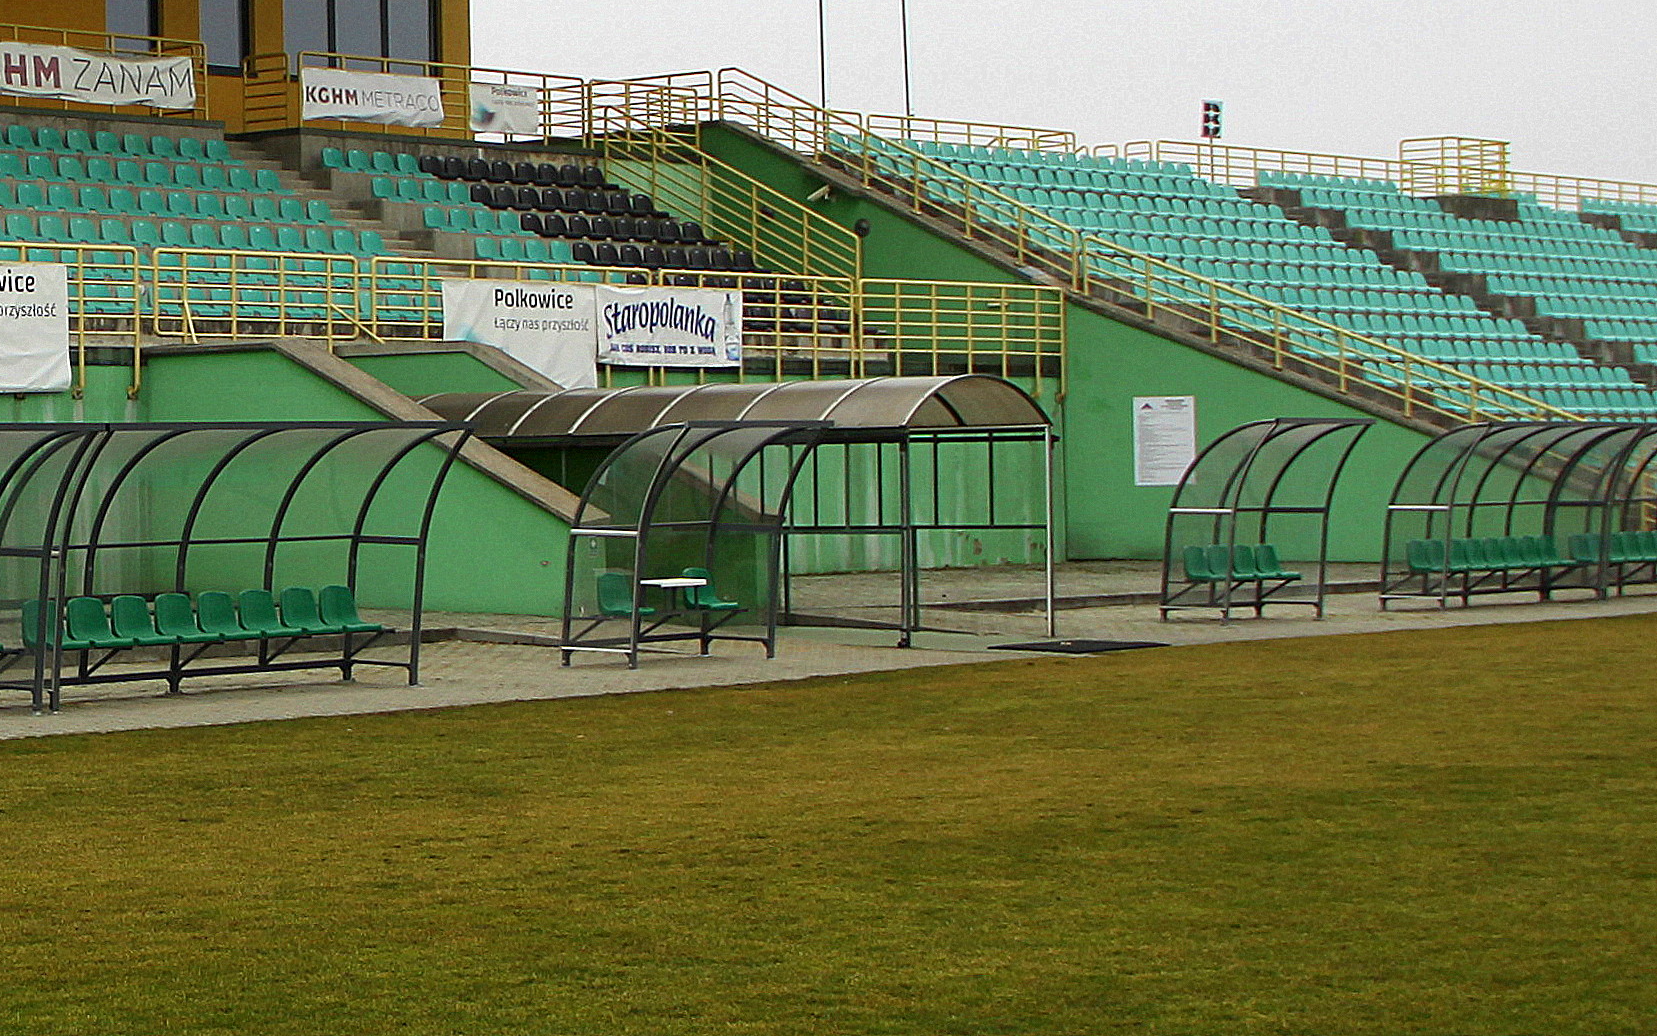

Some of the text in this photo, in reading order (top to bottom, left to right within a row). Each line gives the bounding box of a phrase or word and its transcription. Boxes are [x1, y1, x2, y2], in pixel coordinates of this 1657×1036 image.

[73, 58, 193, 98] ZANAM
[306, 86, 439, 112] KGHM METRACO
[494, 288, 573, 309] Polkowice
[523, 319, 539, 329] nas
[604, 297, 716, 342] Staropolanka
